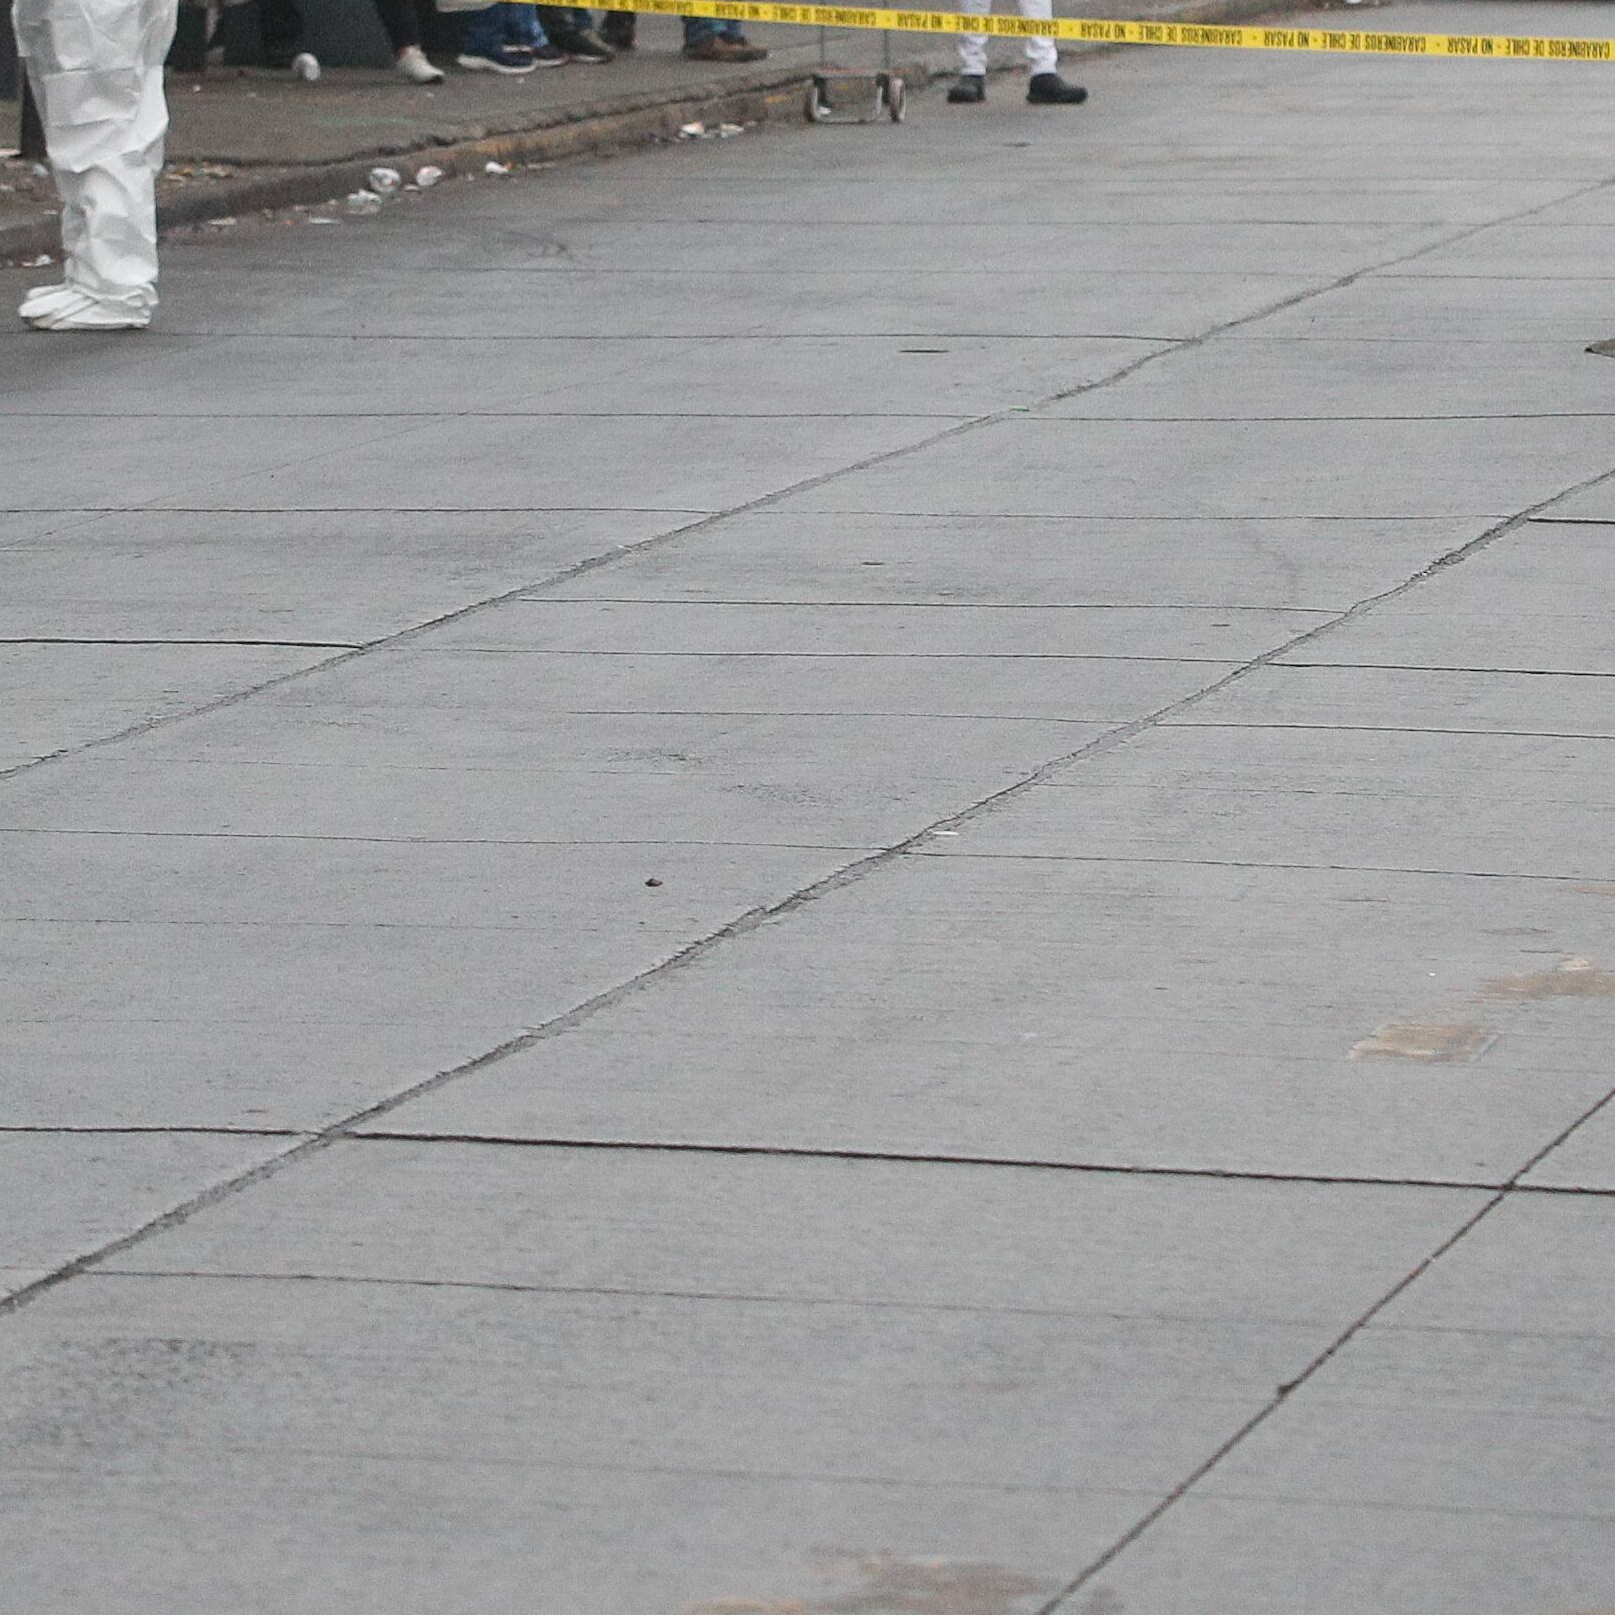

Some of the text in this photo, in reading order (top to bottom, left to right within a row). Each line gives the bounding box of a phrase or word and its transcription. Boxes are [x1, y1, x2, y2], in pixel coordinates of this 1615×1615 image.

[1138, 24, 1310, 46] CARABINEROS DE CHILE NO PASAR
[1322, 32, 1494, 53] CARABINEROS DE CHILE NO PASAR
[1506, 38, 1530, 54] CHILE
[1532, 39, 1545, 55] DE
[1548, 40, 1610, 59] CARABINEROS
